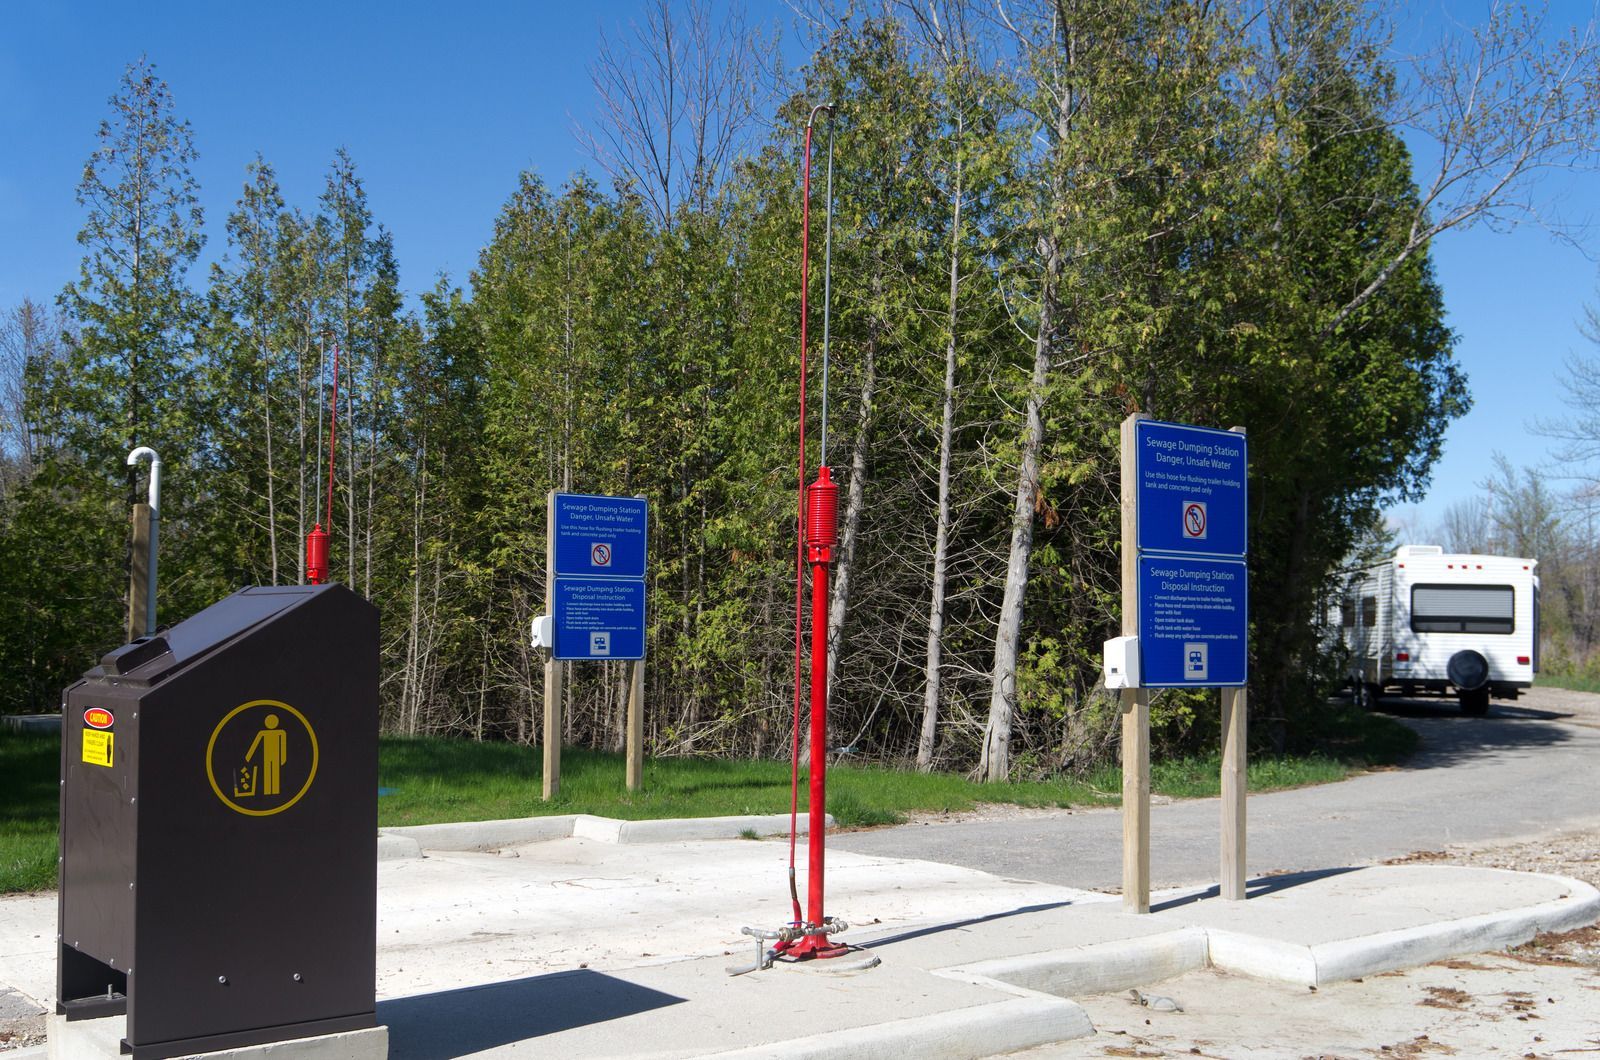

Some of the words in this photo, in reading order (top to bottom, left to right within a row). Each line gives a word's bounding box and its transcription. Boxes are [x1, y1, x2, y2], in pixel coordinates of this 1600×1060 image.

[1146, 437, 1176, 451] Sewage
[1179, 441, 1212, 456] Dumping
[1214, 445, 1239, 457] Station
[1156, 453, 1184, 466] Danger,
[1187, 456, 1209, 467] Unsafe
[1212, 459, 1231, 469] Water
[1187, 475, 1207, 485] flushing
[1222, 478, 1240, 488] holding
[1202, 487, 1212, 495] only
[563, 503, 587, 512] Sewage
[589, 505, 617, 514] Dumping
[1151, 567, 1178, 579] Sewage
[1180, 569, 1210, 581] Dumping
[1212, 571, 1234, 580] Station
[1162, 582, 1189, 592] Disposal
[1191, 583, 1225, 592] Instruction
[90, 713, 108, 724] CAUTION
